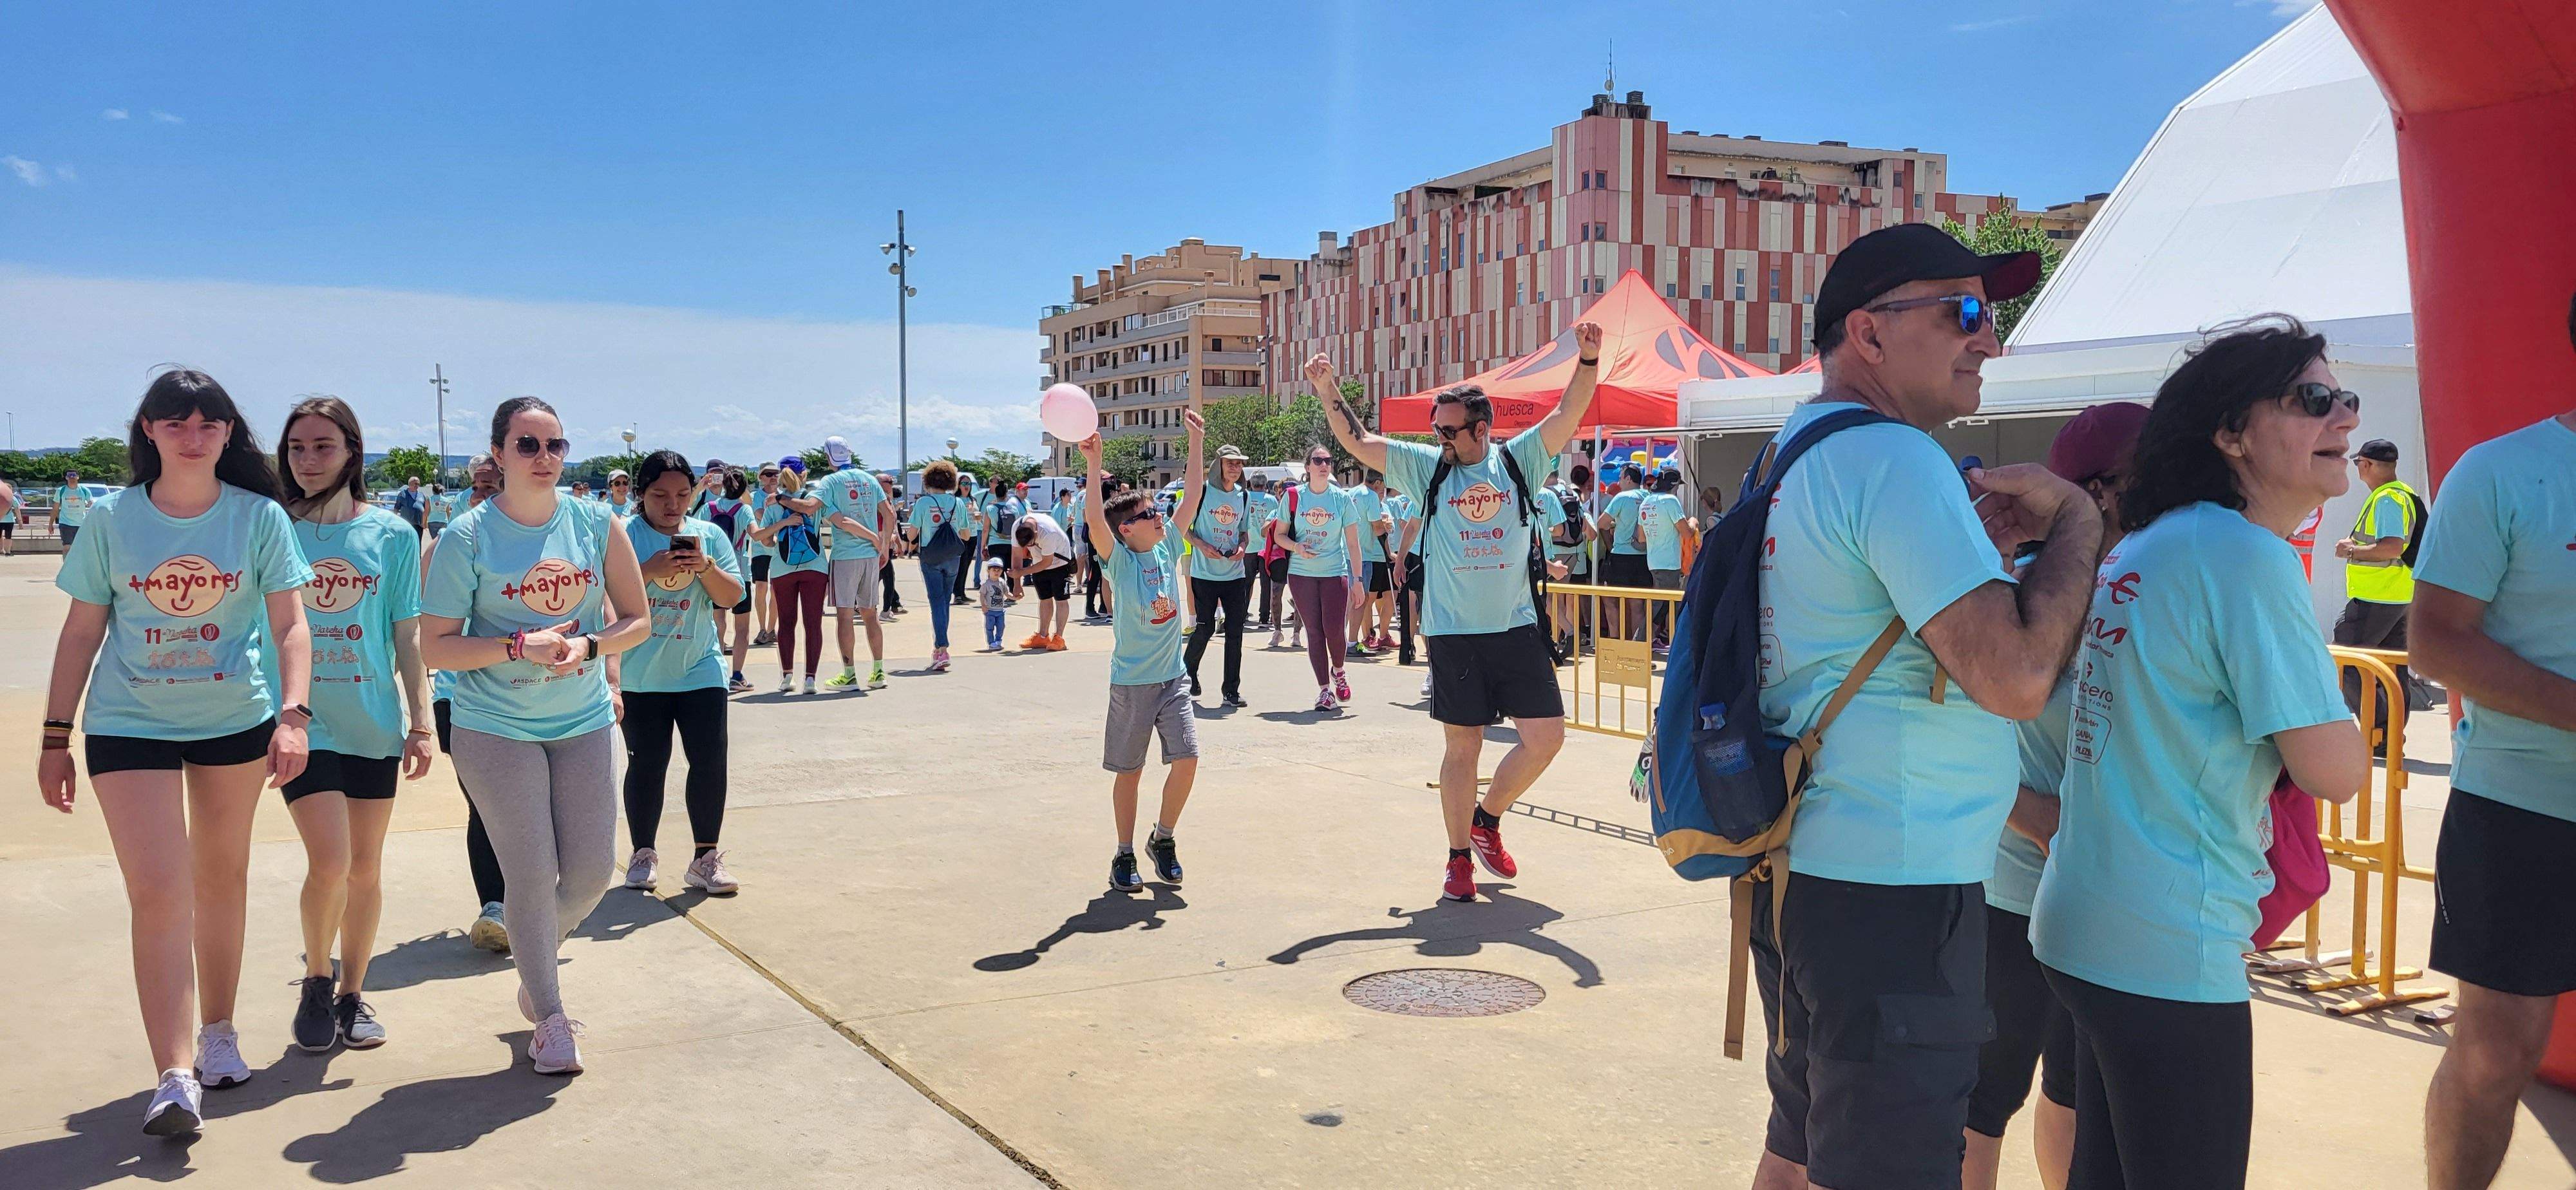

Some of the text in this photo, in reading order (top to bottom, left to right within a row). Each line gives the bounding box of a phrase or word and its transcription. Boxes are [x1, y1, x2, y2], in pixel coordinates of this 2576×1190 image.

[1496, 401, 1533, 417] huesca
[1448, 489, 1511, 513] +mayores
[1459, 531, 1469, 541] 11
[129, 571, 243, 602] +mayores
[305, 574, 381, 600] ayores
[500, 564, 598, 602] +mayores
[145, 628, 161, 644] 11
